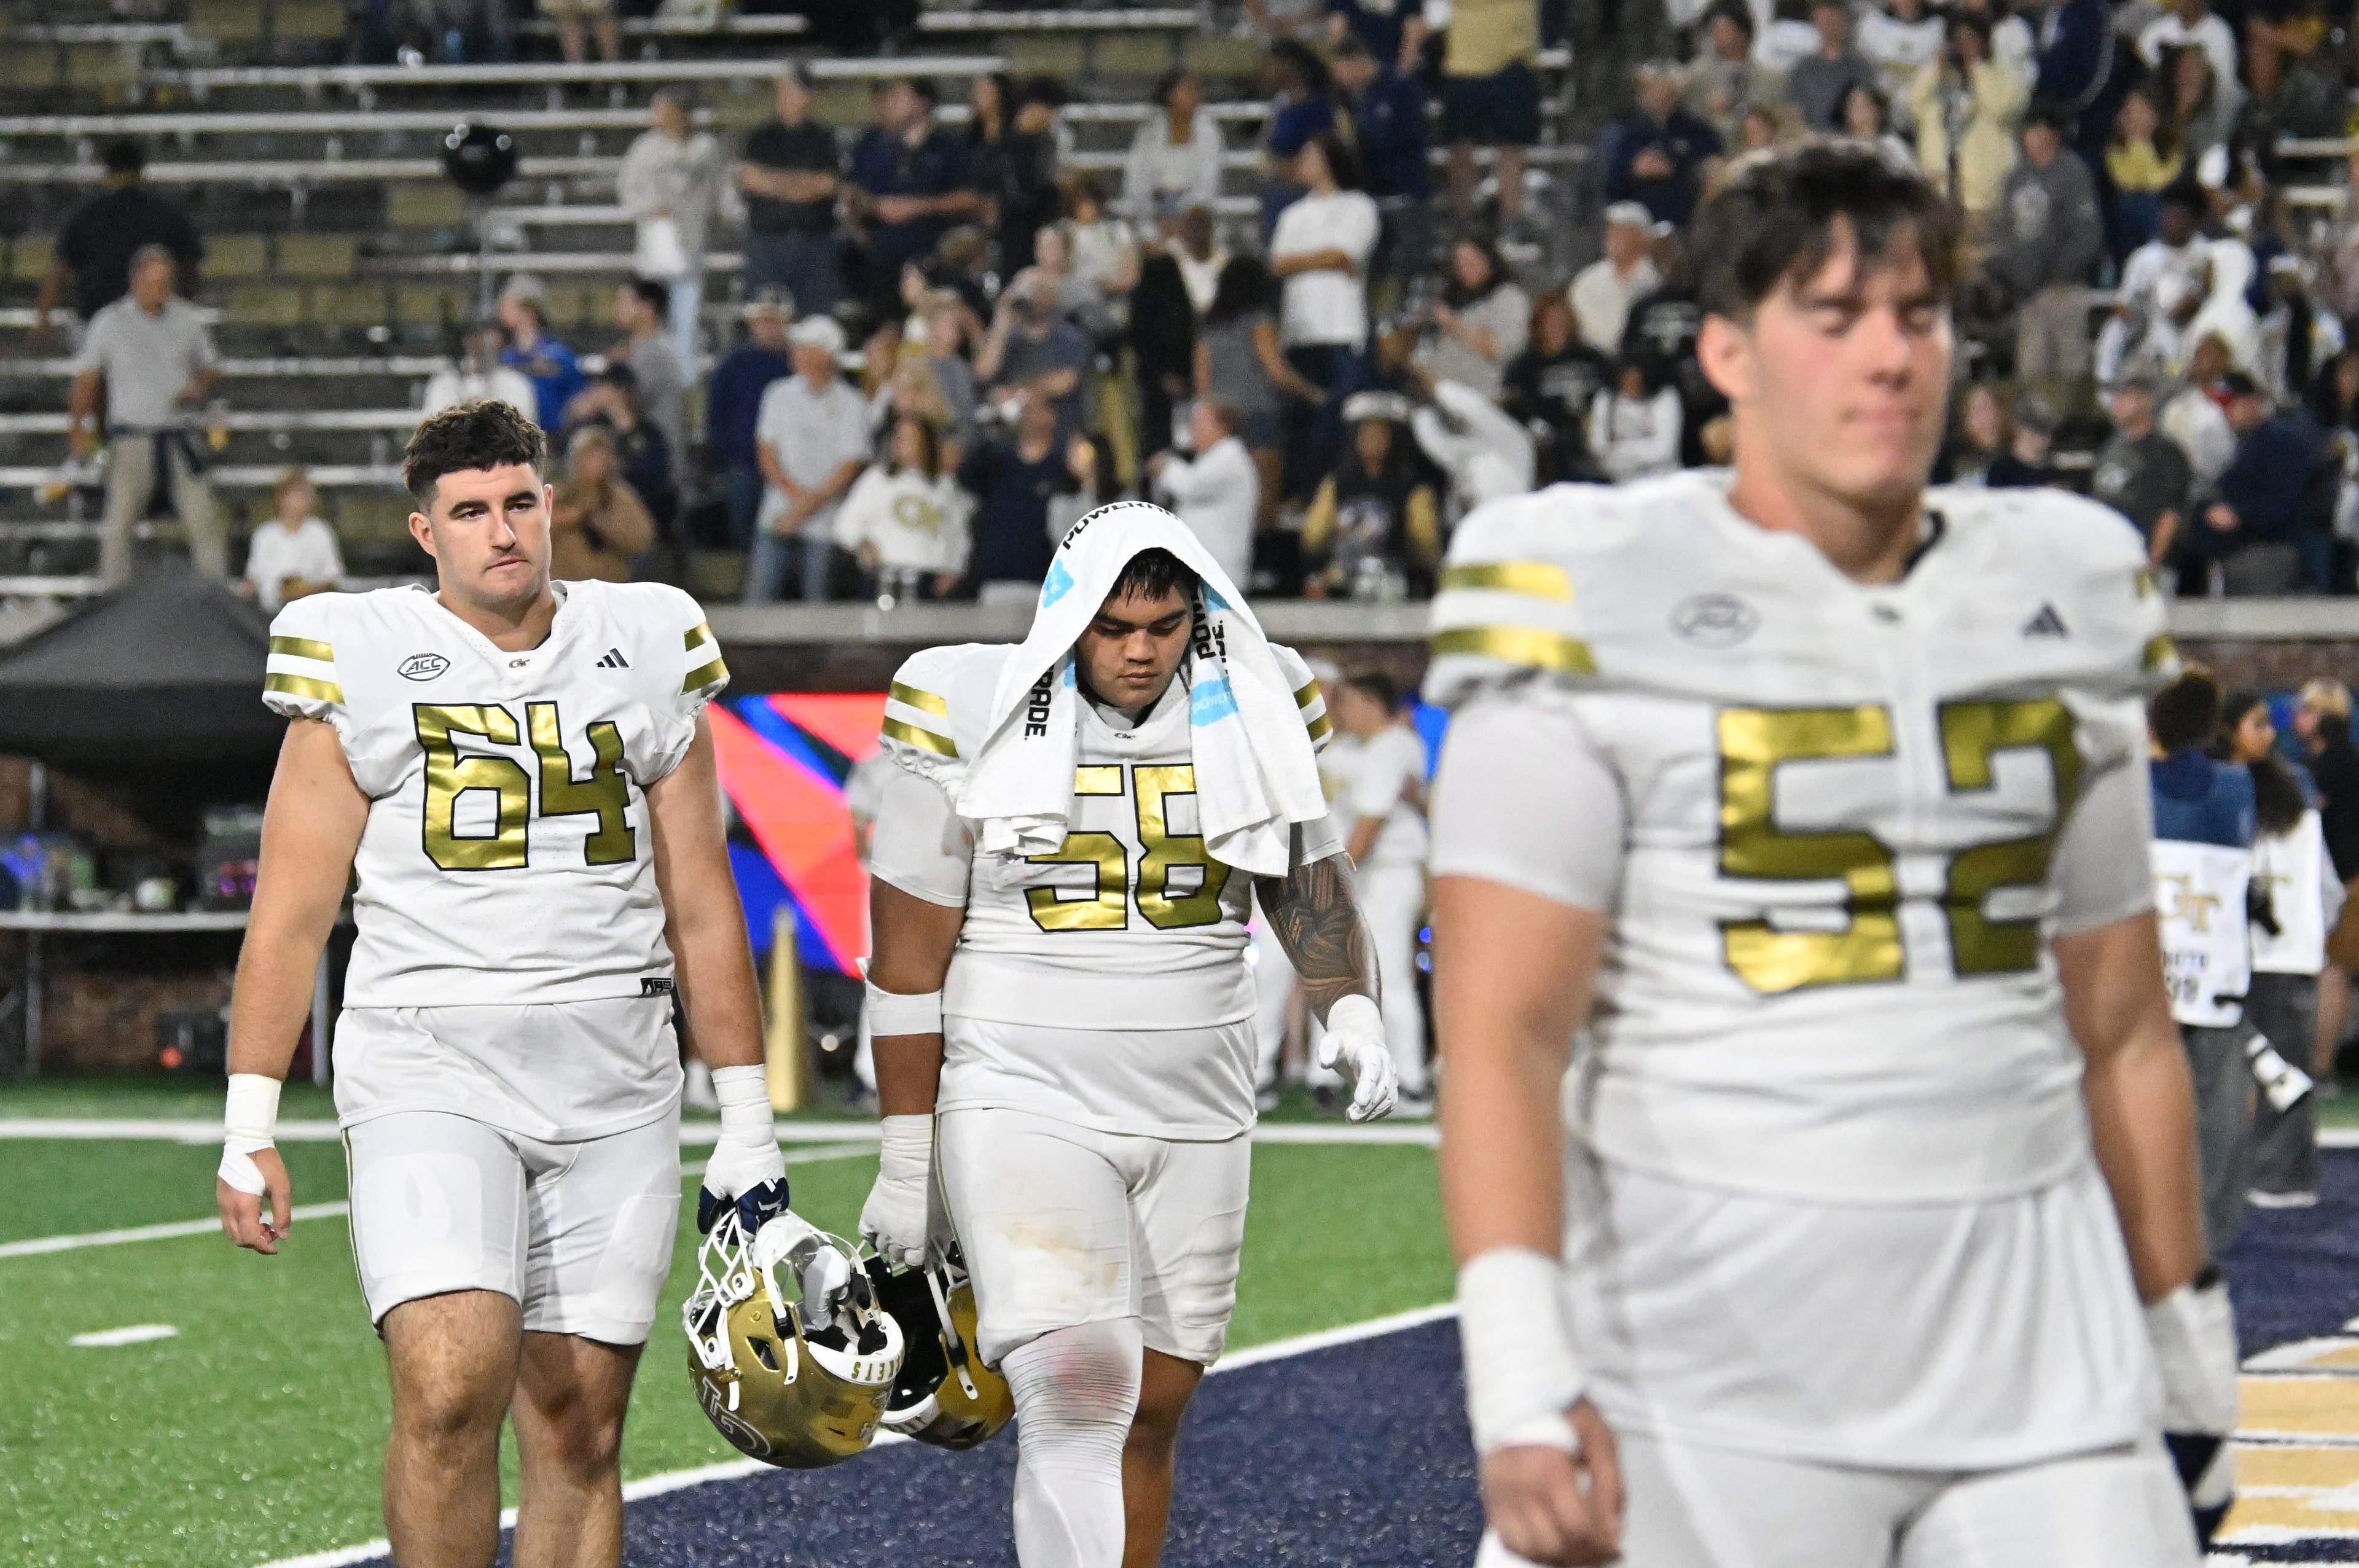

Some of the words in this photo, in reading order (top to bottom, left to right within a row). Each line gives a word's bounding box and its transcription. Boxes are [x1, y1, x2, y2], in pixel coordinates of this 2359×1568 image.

[405, 657, 441, 673] ACC
[1024, 663, 1055, 741] RADE.
[412, 701, 637, 872] 64
[1023, 763, 1232, 933] 58
[1716, 695, 2083, 994] 52
